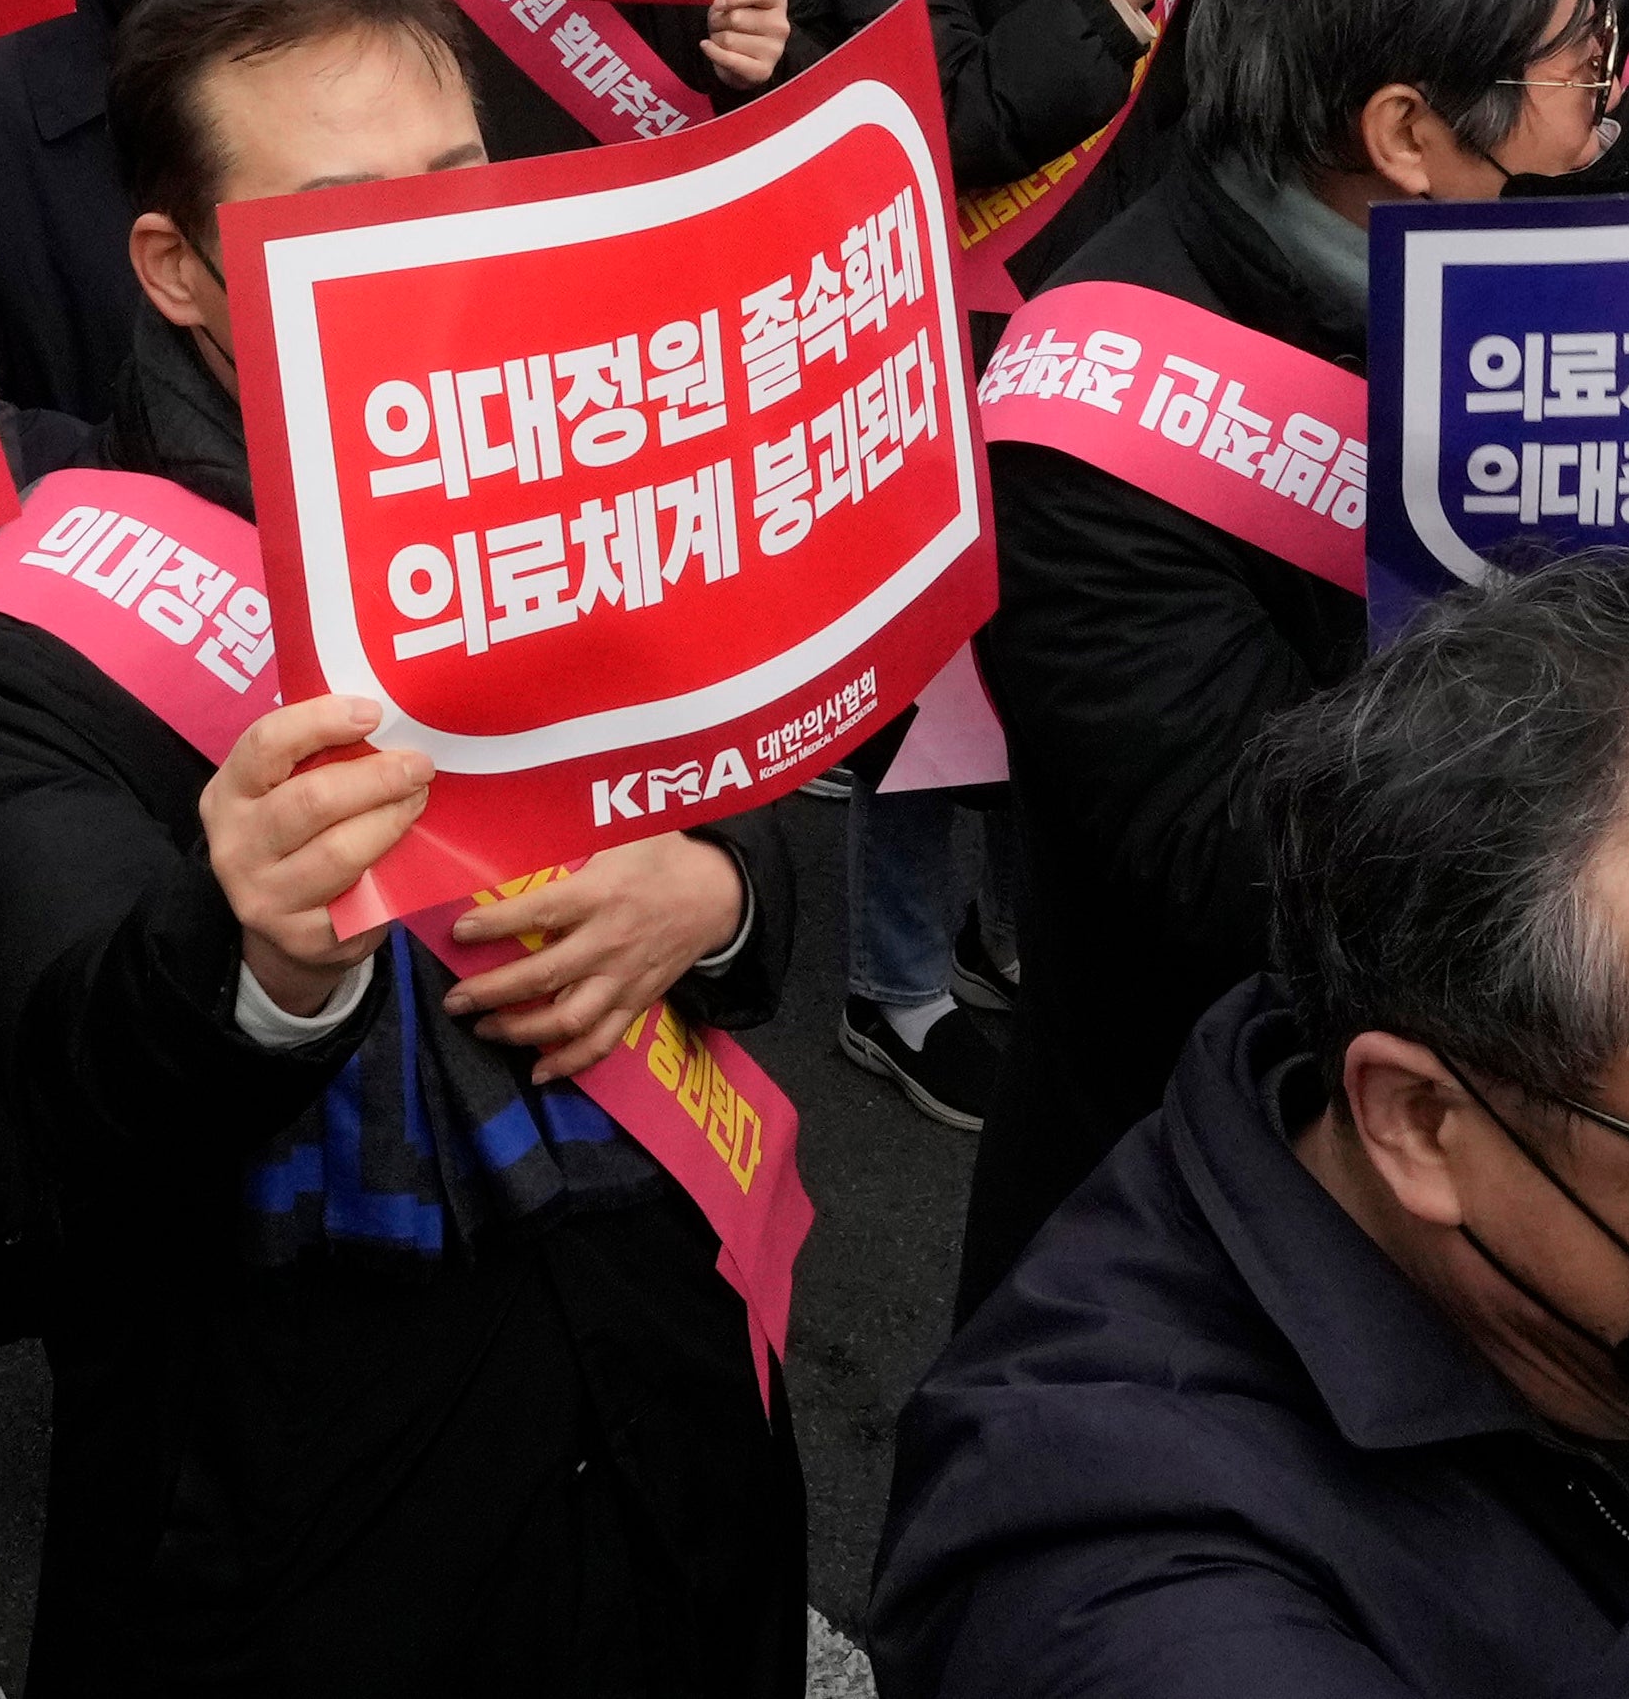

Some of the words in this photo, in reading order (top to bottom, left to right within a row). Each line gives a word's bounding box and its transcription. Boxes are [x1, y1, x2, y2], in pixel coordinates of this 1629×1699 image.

[550, 13, 692, 141] 확대추진
[361, 308, 731, 504] 의대정원
[739, 182, 931, 401] 졸속확대
[386, 440, 743, 667] 의료체계
[752, 327, 940, 558] 붕괴된다
[1139, 352, 1370, 532] 일방적인
[18, 501, 277, 692] 의대정원
[591, 747, 753, 827] KMA
[756, 666, 877, 763] 대한의사협회
